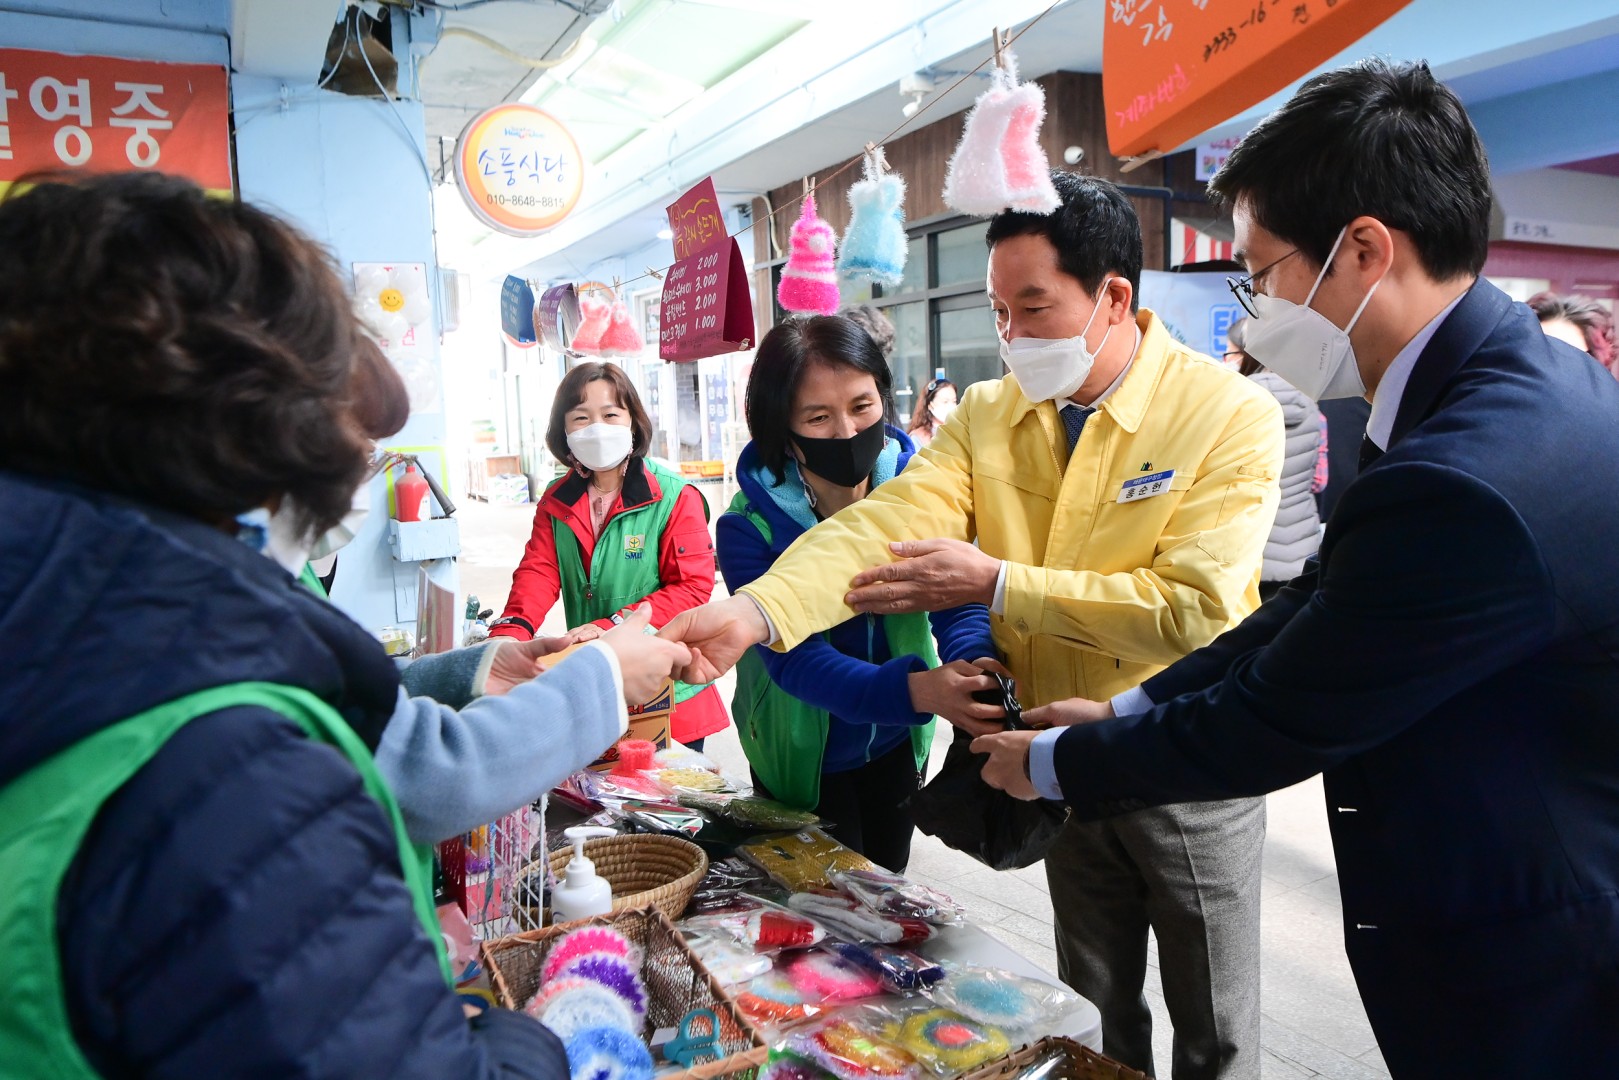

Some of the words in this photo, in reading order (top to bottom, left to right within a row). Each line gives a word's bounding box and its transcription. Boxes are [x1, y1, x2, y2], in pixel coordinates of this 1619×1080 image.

[0, 72, 173, 168] 영중
[478, 147, 568, 186] 소풍식당
[487, 193, 565, 208] 010-8648-8815
